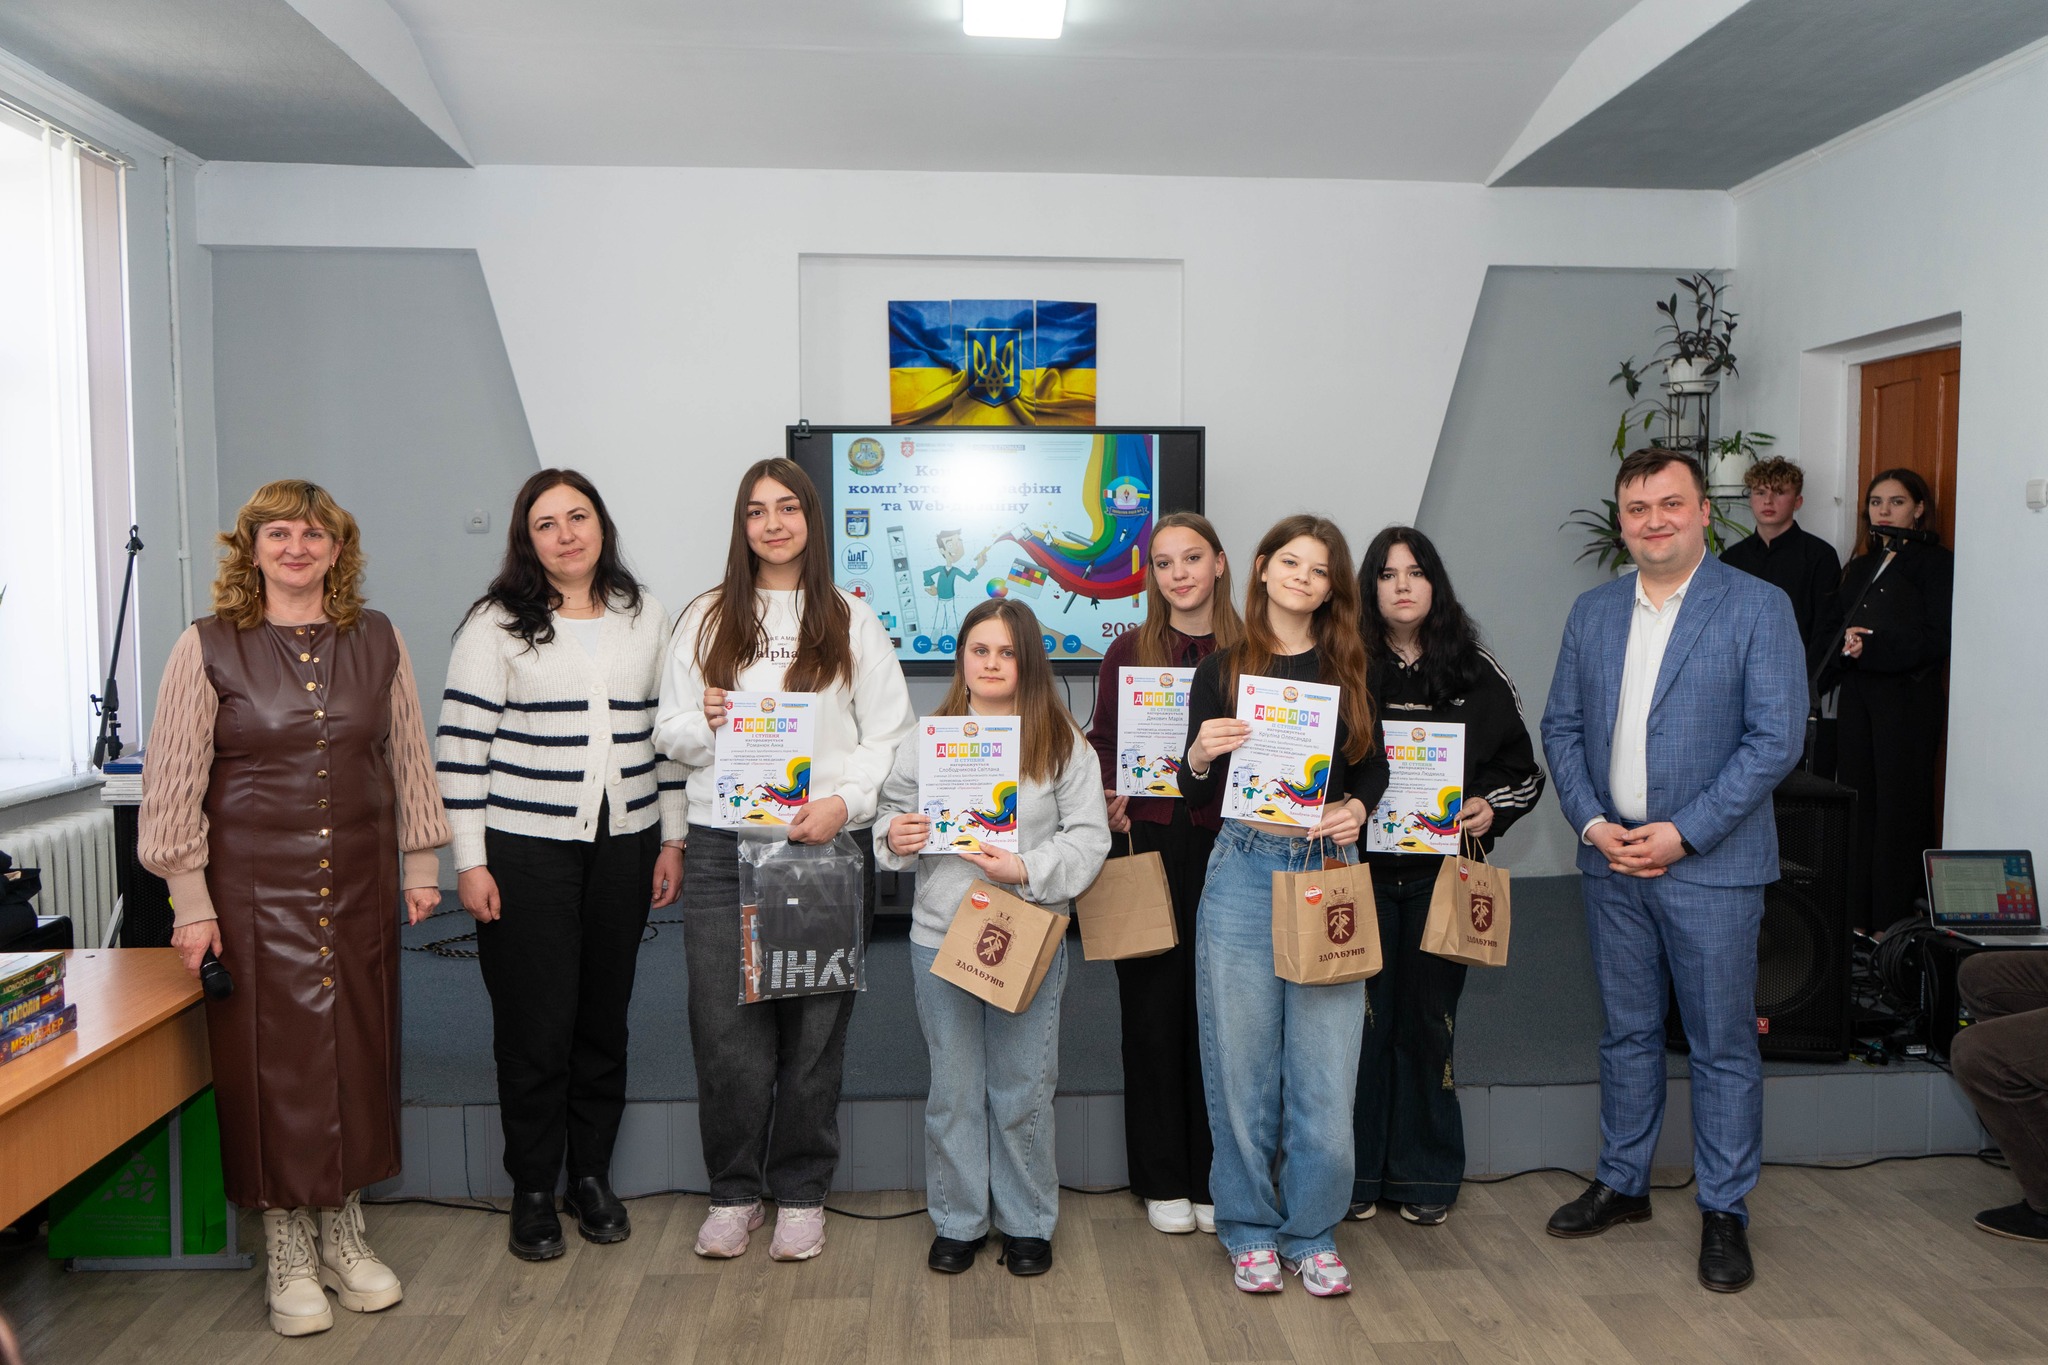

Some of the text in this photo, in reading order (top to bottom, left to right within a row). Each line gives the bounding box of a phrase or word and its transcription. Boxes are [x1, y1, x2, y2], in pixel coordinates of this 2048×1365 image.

[881, 503, 902, 511] та
[1101, 622, 1138, 638] 20
[757, 647, 798, 662] alpha
[1254, 704, 1321, 728] ДИПЛОМ
[734, 719, 798, 732] ДИПЛОМ
[937, 743, 1002, 757] ДИПЛОМ
[1386, 746, 1447, 761] ДИПЛОМ
[1318, 947, 1366, 963] ЗДОЛБУНІВ
[955, 959, 1005, 989] ЗДОЛБУНІВ
